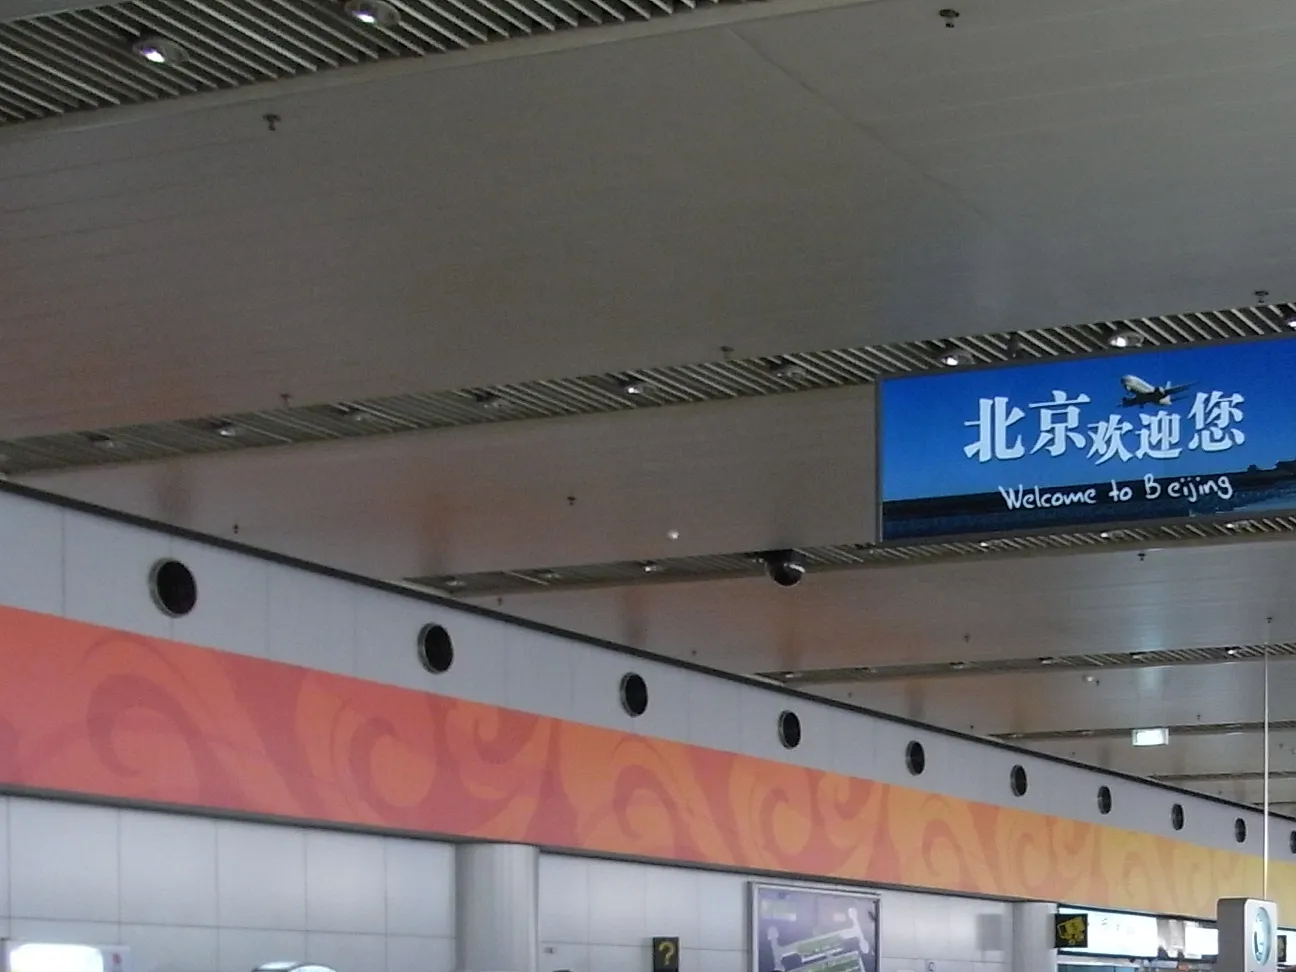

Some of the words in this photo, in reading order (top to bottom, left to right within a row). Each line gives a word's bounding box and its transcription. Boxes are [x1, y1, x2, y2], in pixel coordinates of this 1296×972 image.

[964, 389, 1246, 465] 北京欢迎您
[999, 484, 1097, 511] Welcome
[1109, 479, 1133, 502] to
[1144, 473, 1234, 502] Beijing
